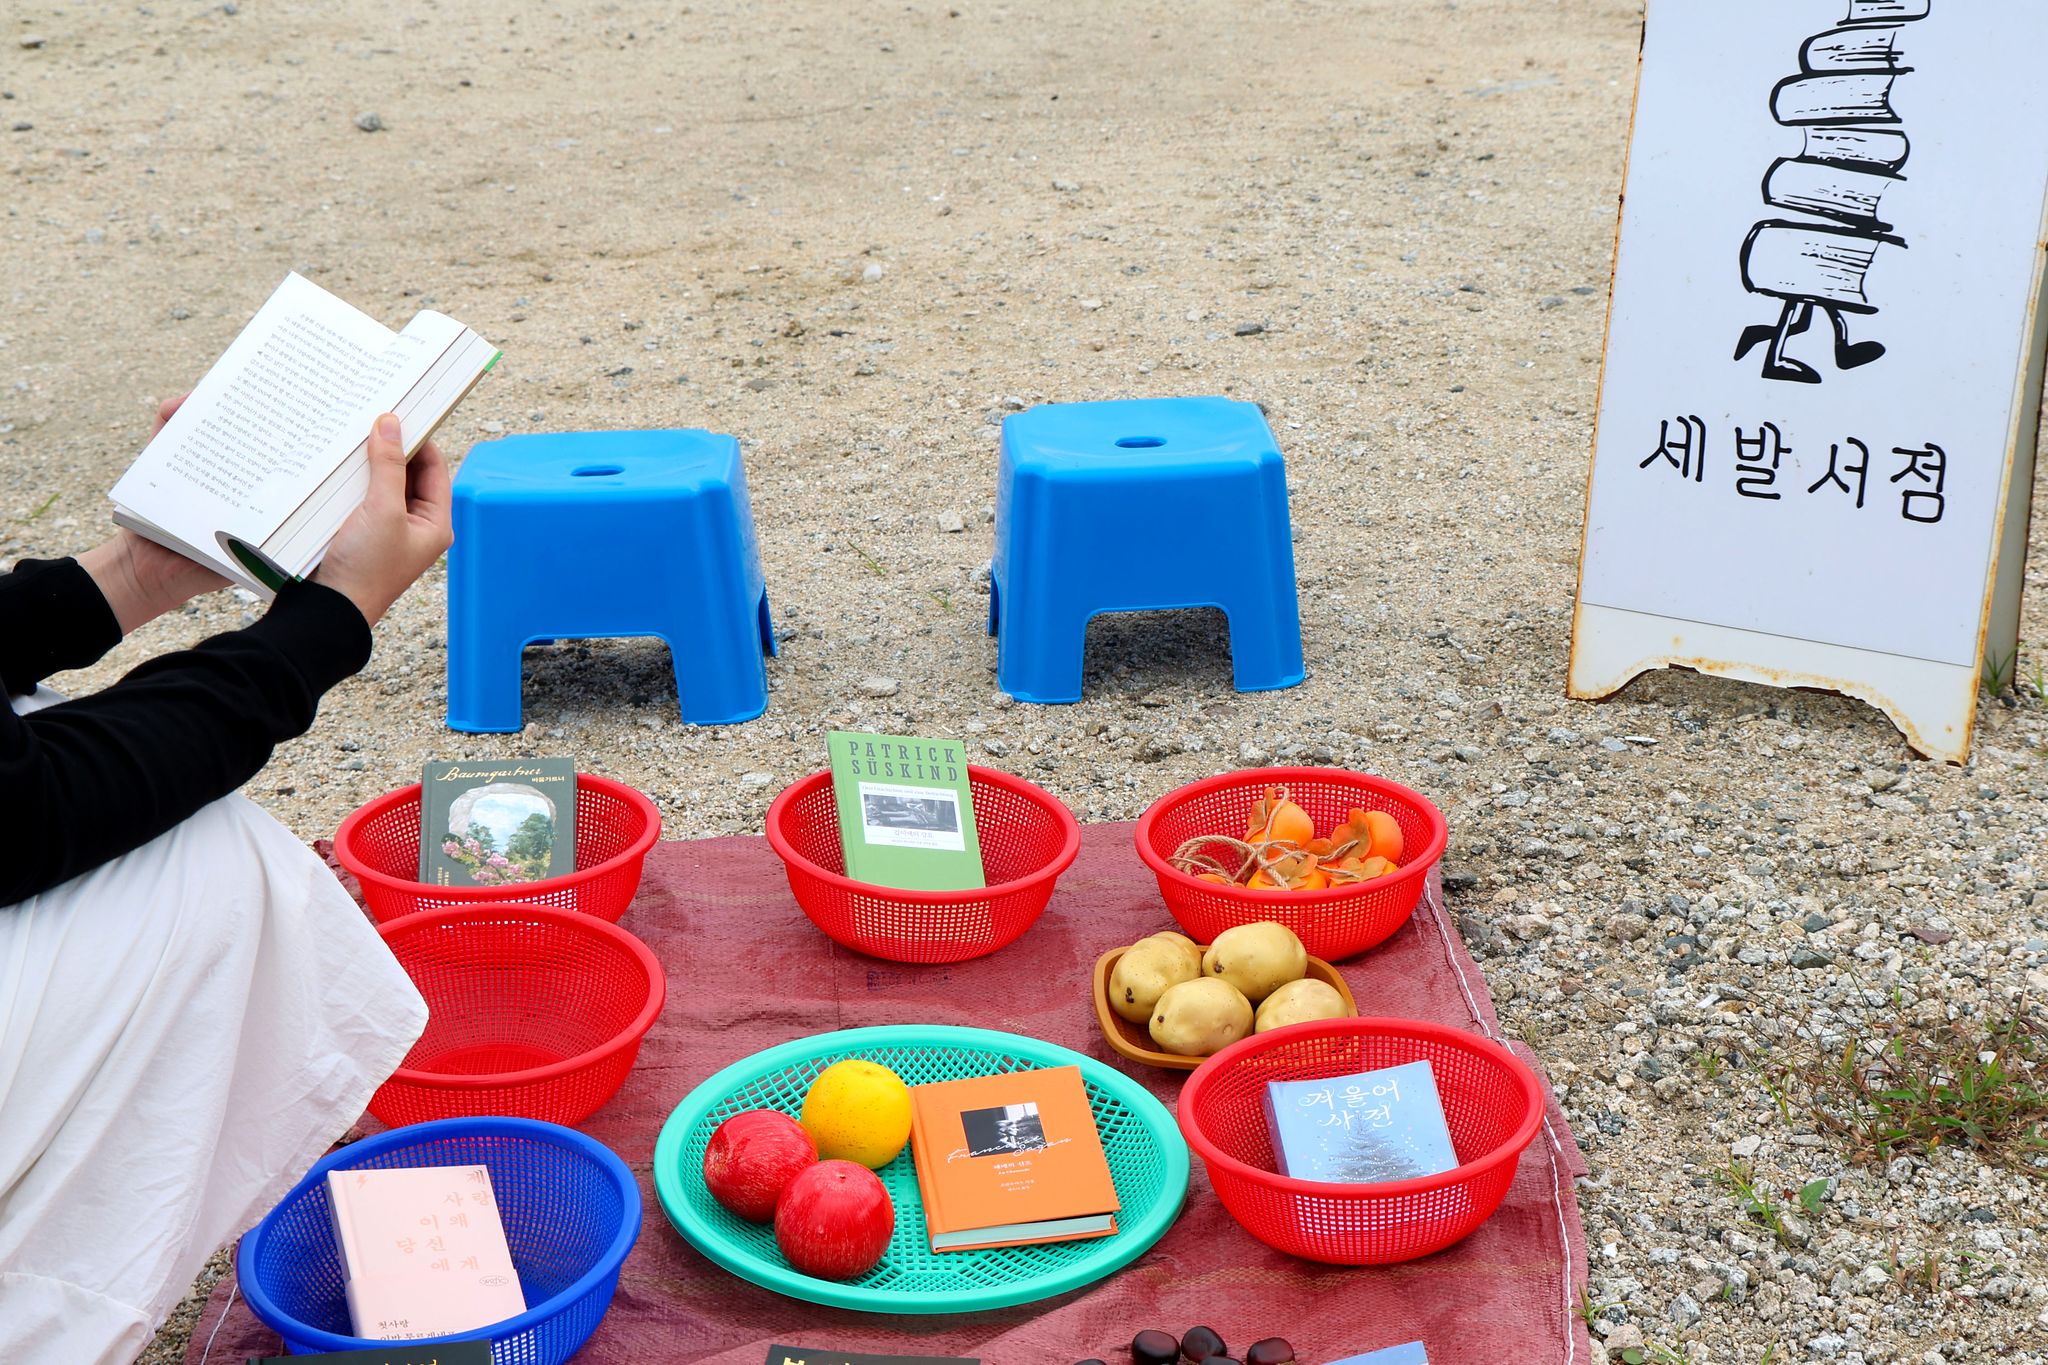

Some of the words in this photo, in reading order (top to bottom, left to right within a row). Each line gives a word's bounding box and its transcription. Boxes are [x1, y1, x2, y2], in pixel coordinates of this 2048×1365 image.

[849, 741, 956, 763] PATRICK
[435, 766, 543, 783] Baumgartner
[852, 758, 958, 781] SÜSKIND
[1299, 1074, 1400, 1110] 겨울어
[1317, 1101, 1393, 1130] 사전
[378, 1319, 409, 1329] 첫사랑
